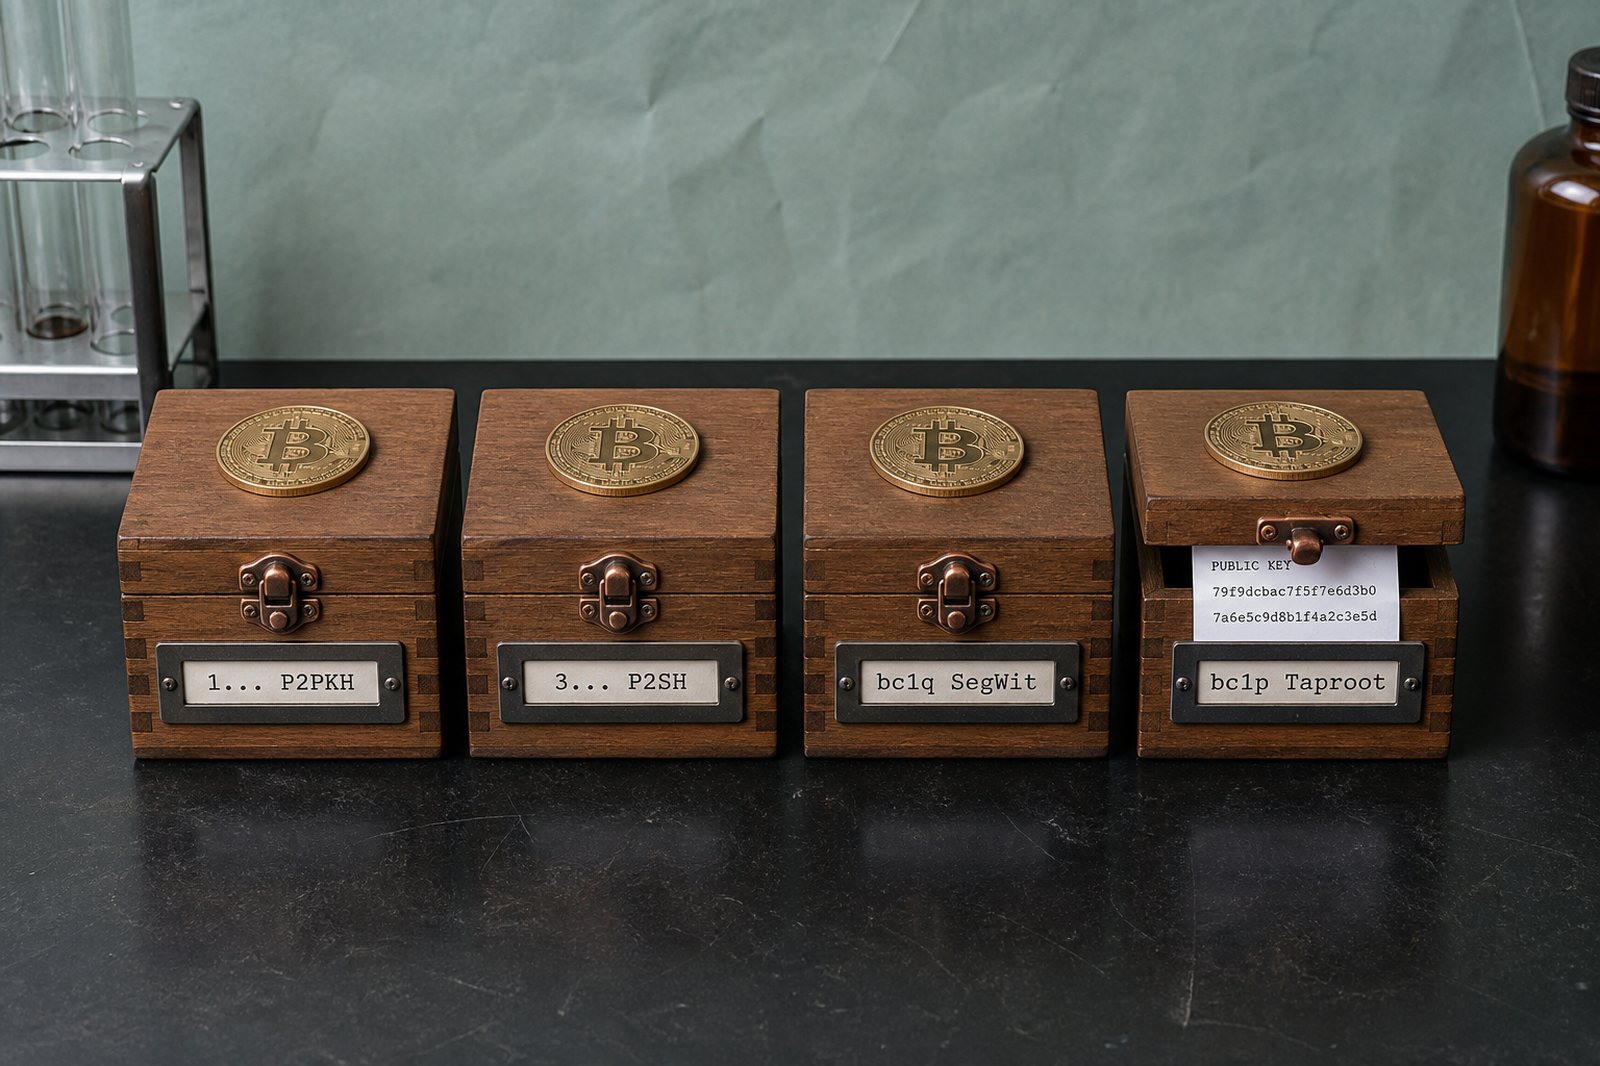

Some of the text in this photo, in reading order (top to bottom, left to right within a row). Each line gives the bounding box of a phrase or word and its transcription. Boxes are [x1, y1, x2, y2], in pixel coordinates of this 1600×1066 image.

[1211, 559, 1292, 571] PUBLIC KEY
[1212, 584, 1377, 598] 79f9dcbac7f5f7e6d3b0
[1213, 610, 1378, 623] 7a6e5c9d8b1f4a2c3e5d
[208, 673, 355, 691] 1... P2PKH
[555, 673, 687, 691] 3... P2SH
[876, 672, 1037, 695] bc1q SegWit
[1210, 673, 1386, 695] bc1p Taproot
